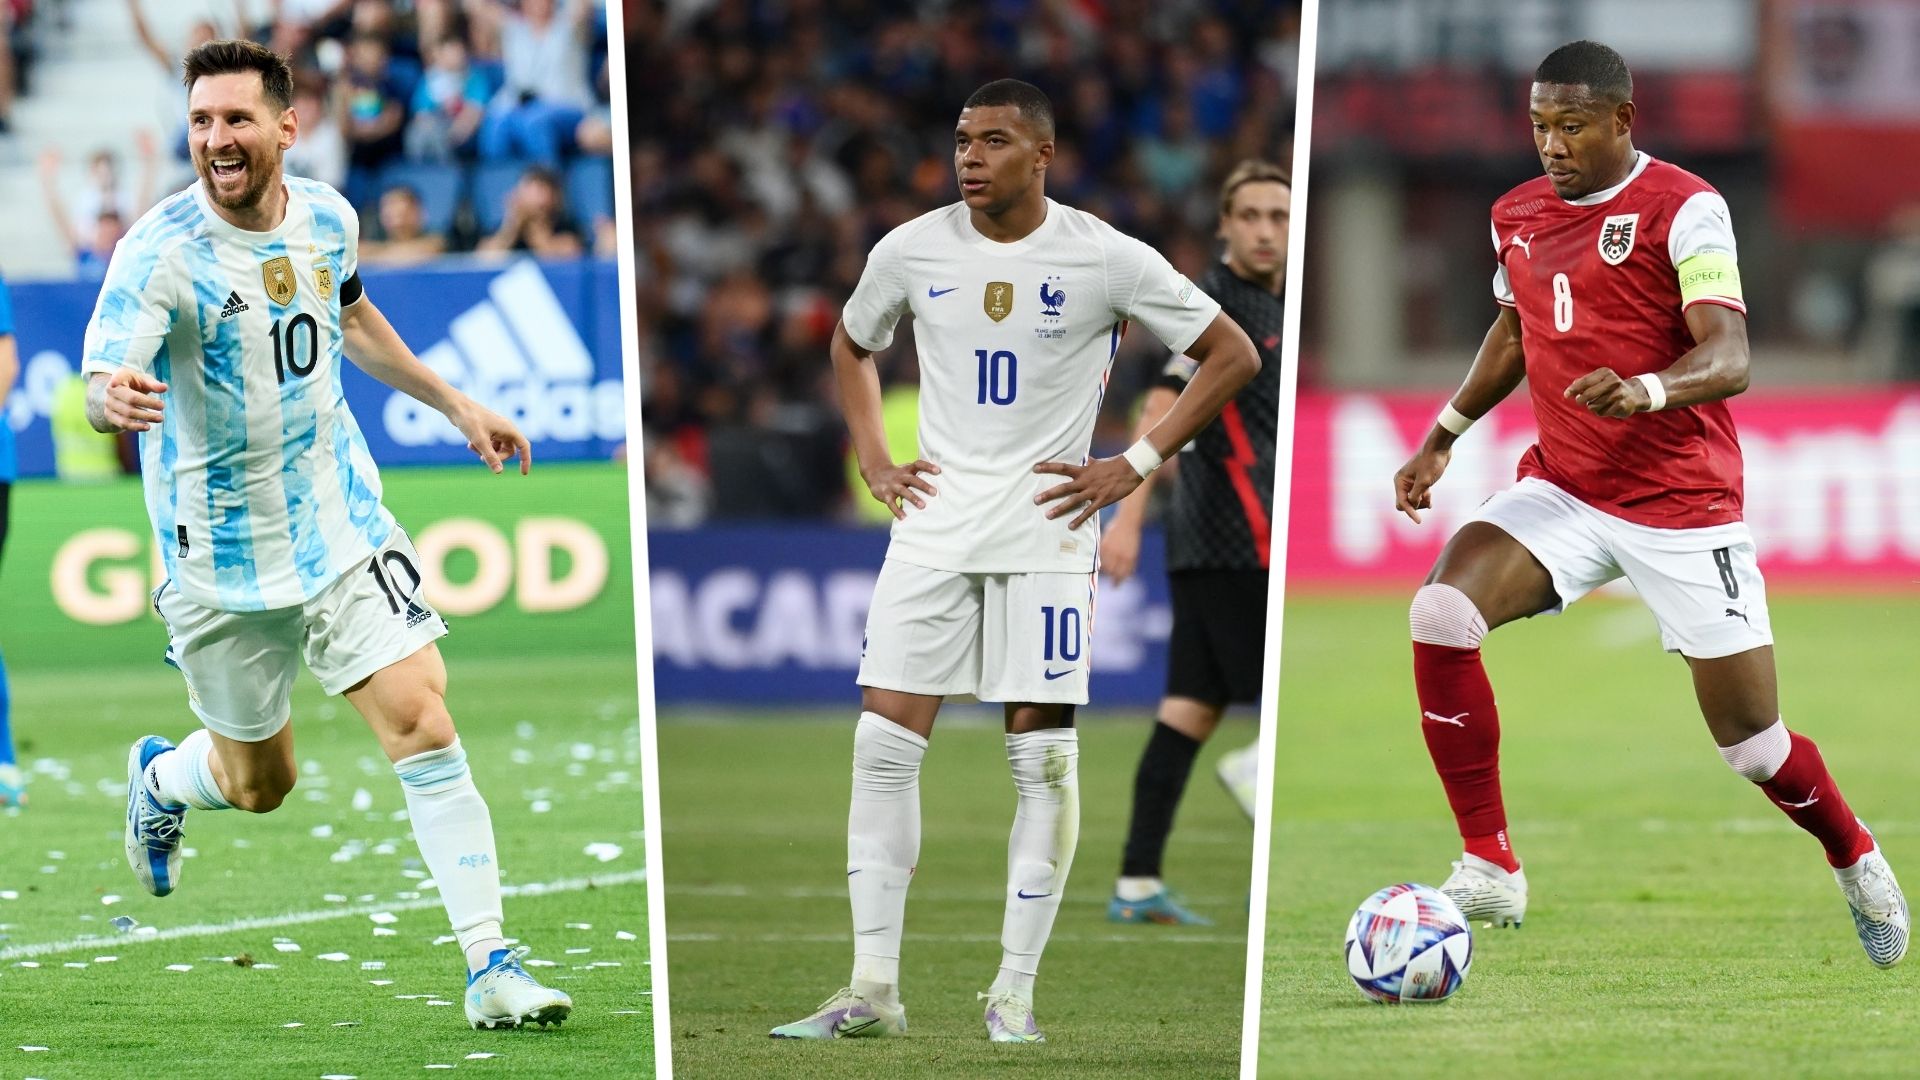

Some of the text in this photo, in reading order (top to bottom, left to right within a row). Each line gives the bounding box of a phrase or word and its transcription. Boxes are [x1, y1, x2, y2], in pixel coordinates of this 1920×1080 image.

[221, 303, 250, 319] adidas
[1553, 272, 1573, 332] 8
[269, 313, 318, 385] 10
[975, 349, 1018, 405] 10
[382, 378, 627, 447] adas
[367, 549, 422, 615] 10
[1712, 547, 1739, 600] 8
[406, 610, 433, 629] adidas
[1041, 606, 1081, 662] 10
